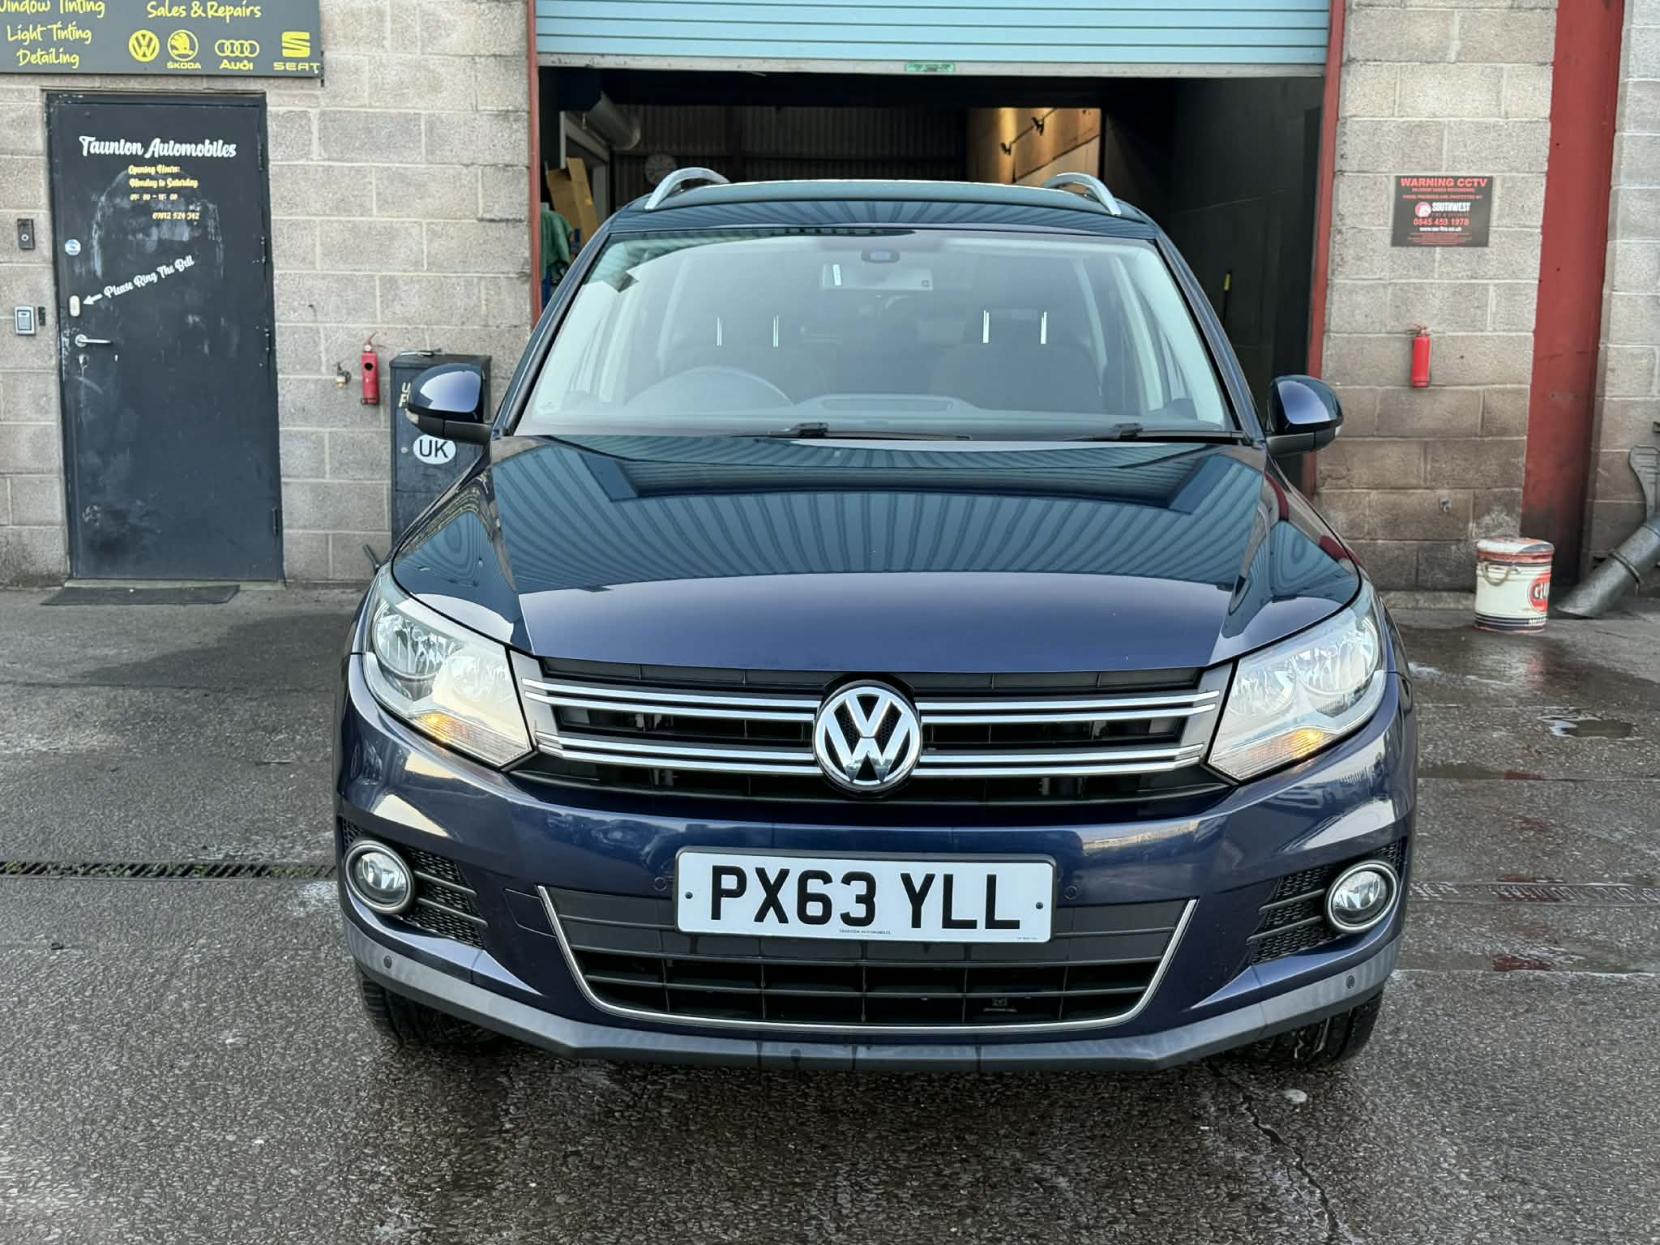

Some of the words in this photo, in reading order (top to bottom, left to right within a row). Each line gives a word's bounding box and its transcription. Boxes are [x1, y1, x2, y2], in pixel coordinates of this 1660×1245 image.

[146, 0, 187, 18] Sales
[190, 1, 206, 18] &
[207, 0, 262, 23] Repairs
[7, 24, 47, 45] Light
[47, 21, 92, 44] Tinting
[16, 47, 80, 69] Detailing
[219, 59, 254, 71] Audi
[273, 61, 320, 74] SEAT
[79, 135, 144, 156] Taunton
[143, 137, 237, 158] Automobiles
[1400, 178, 1454, 187] WARNING
[1456, 178, 1488, 187] CCTV
[103, 281, 134, 299] Please
[133, 271, 159, 288] Ring
[157, 264, 175, 279] The
[174, 255, 195, 272] Bell
[418, 438, 449, 459] UK
[710, 864, 876, 928] PX63
[899, 872, 1022, 930] YLL
